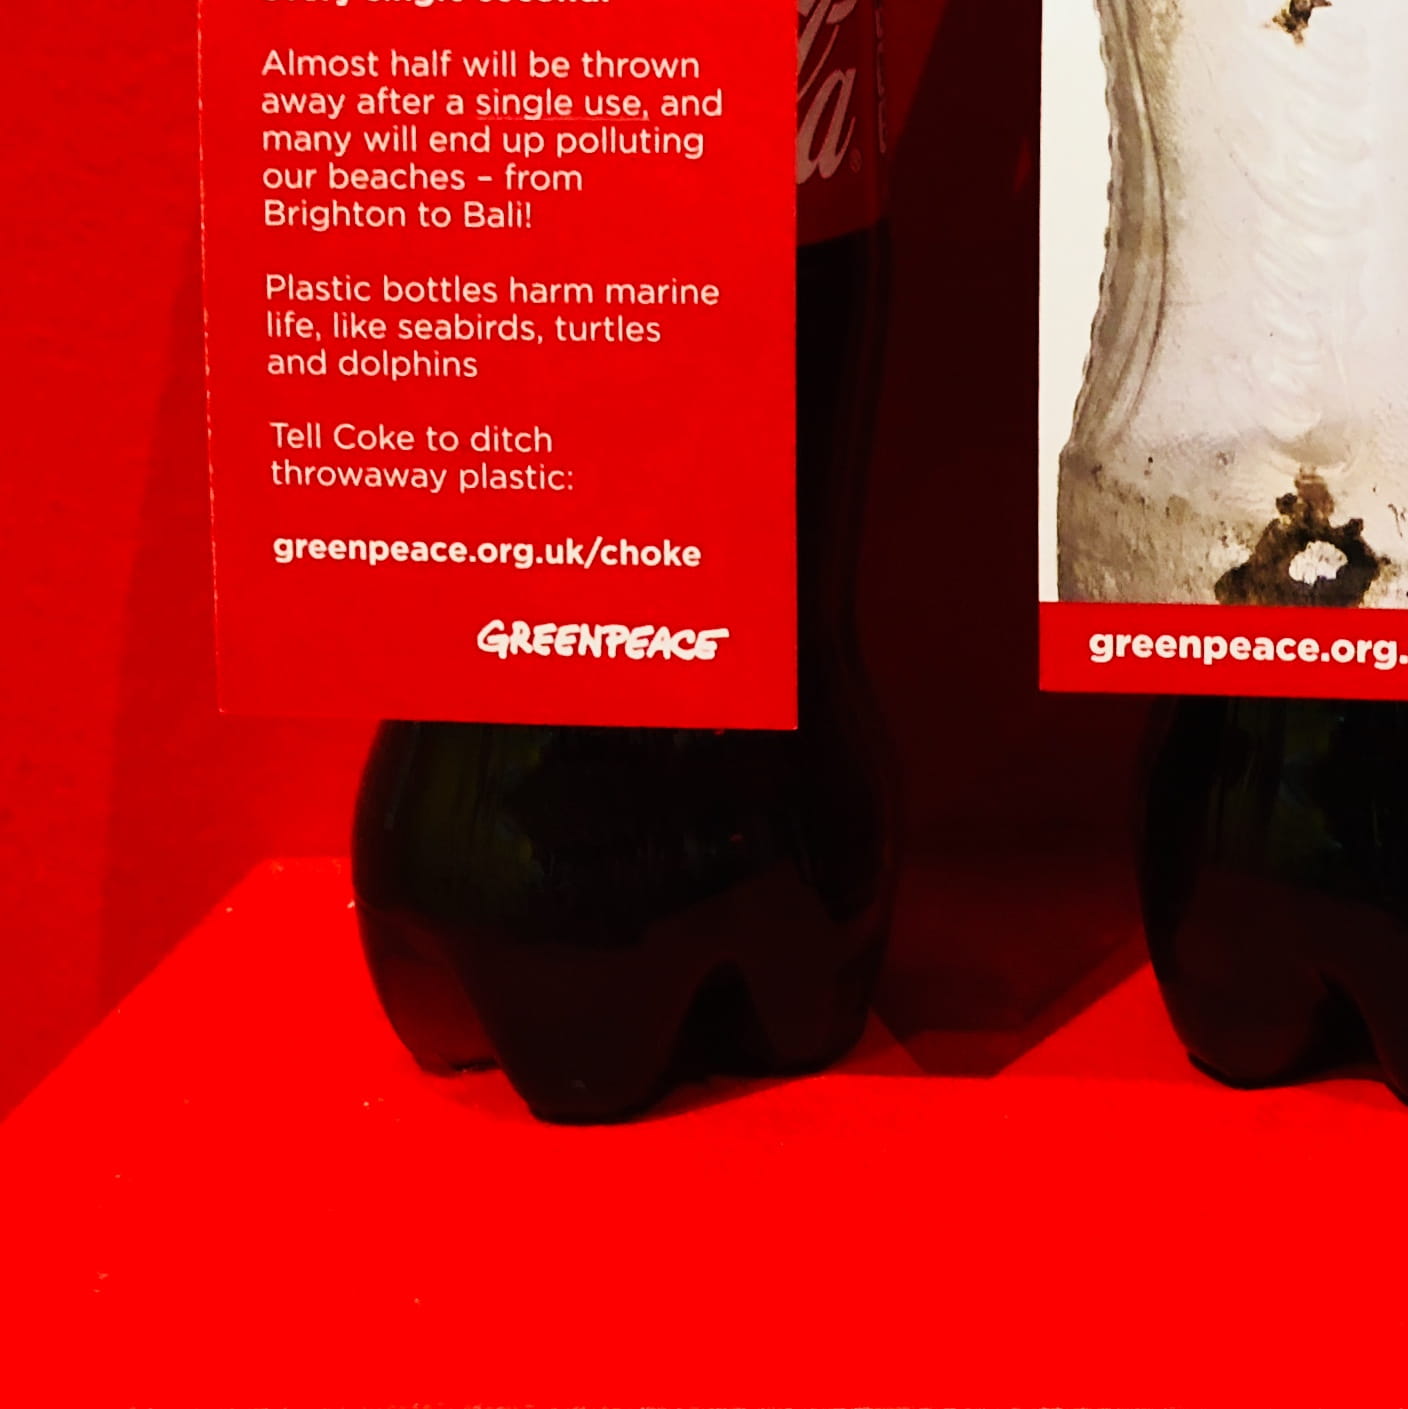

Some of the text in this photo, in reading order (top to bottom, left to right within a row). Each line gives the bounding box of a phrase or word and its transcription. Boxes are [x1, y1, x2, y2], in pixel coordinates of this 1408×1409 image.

[261, 48, 700, 79] Almost half will be thrown
[261, 85, 723, 121] away after a single use, and
[262, 124, 704, 160] many will end up polluting
[262, 167, 318, 190] our
[328, 161, 466, 191] beaches
[505, 162, 583, 191] from
[264, 198, 531, 232] Brighton to Bali!
[266, 273, 720, 306] Plastic bottles harm marine
[267, 310, 661, 345] life, like seabirds, turtles
[267, 348, 478, 382] and dolphins
[269, 421, 553, 453] Tell Coke to ditch
[270, 458, 573, 494] throwaway plastic:
[273, 535, 702, 570] greenpeace.org.uk/choke
[476, 619, 730, 661] GREENPEACE
